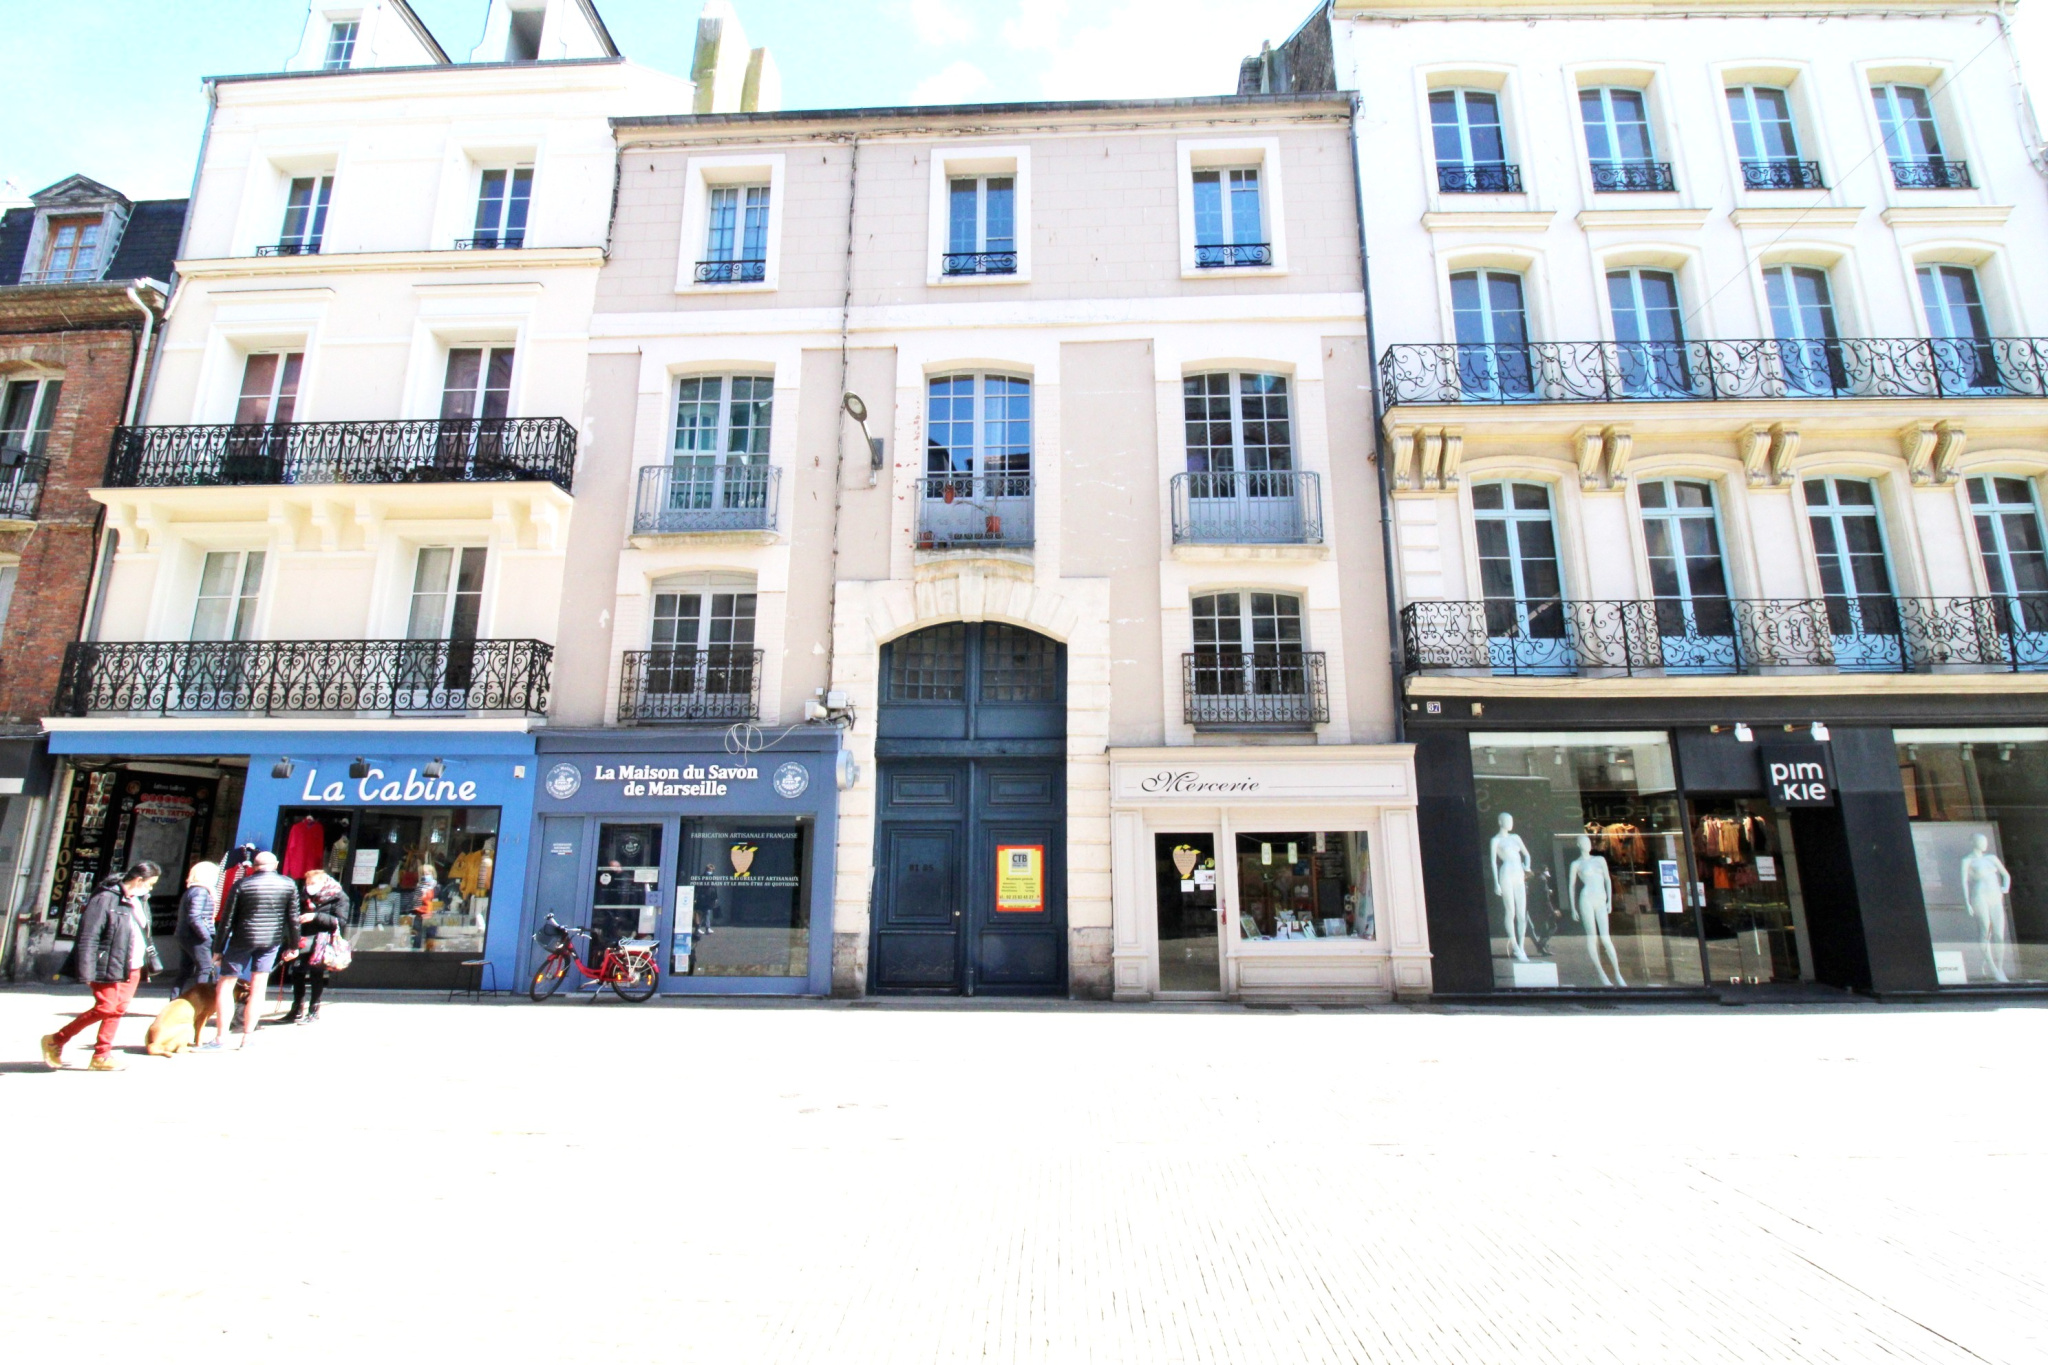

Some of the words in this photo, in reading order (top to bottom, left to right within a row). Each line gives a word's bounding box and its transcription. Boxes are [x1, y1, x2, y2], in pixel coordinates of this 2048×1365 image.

[594, 765, 615, 780] La
[618, 765, 679, 780] Maison
[683, 764, 705, 779] du
[708, 764, 758, 779] Savon
[1769, 762, 1824, 786] pim
[302, 769, 346, 801] La
[358, 768, 477, 801] Cabine
[624, 781, 645, 796] de
[648, 781, 727, 796] Marseille
[1141, 771, 1260, 793] Mercerie
[51, 787, 84, 901] TATTOOS
[766, 832, 798, 840] FRANÇAISE
[1012, 854, 1028, 863] CTB
